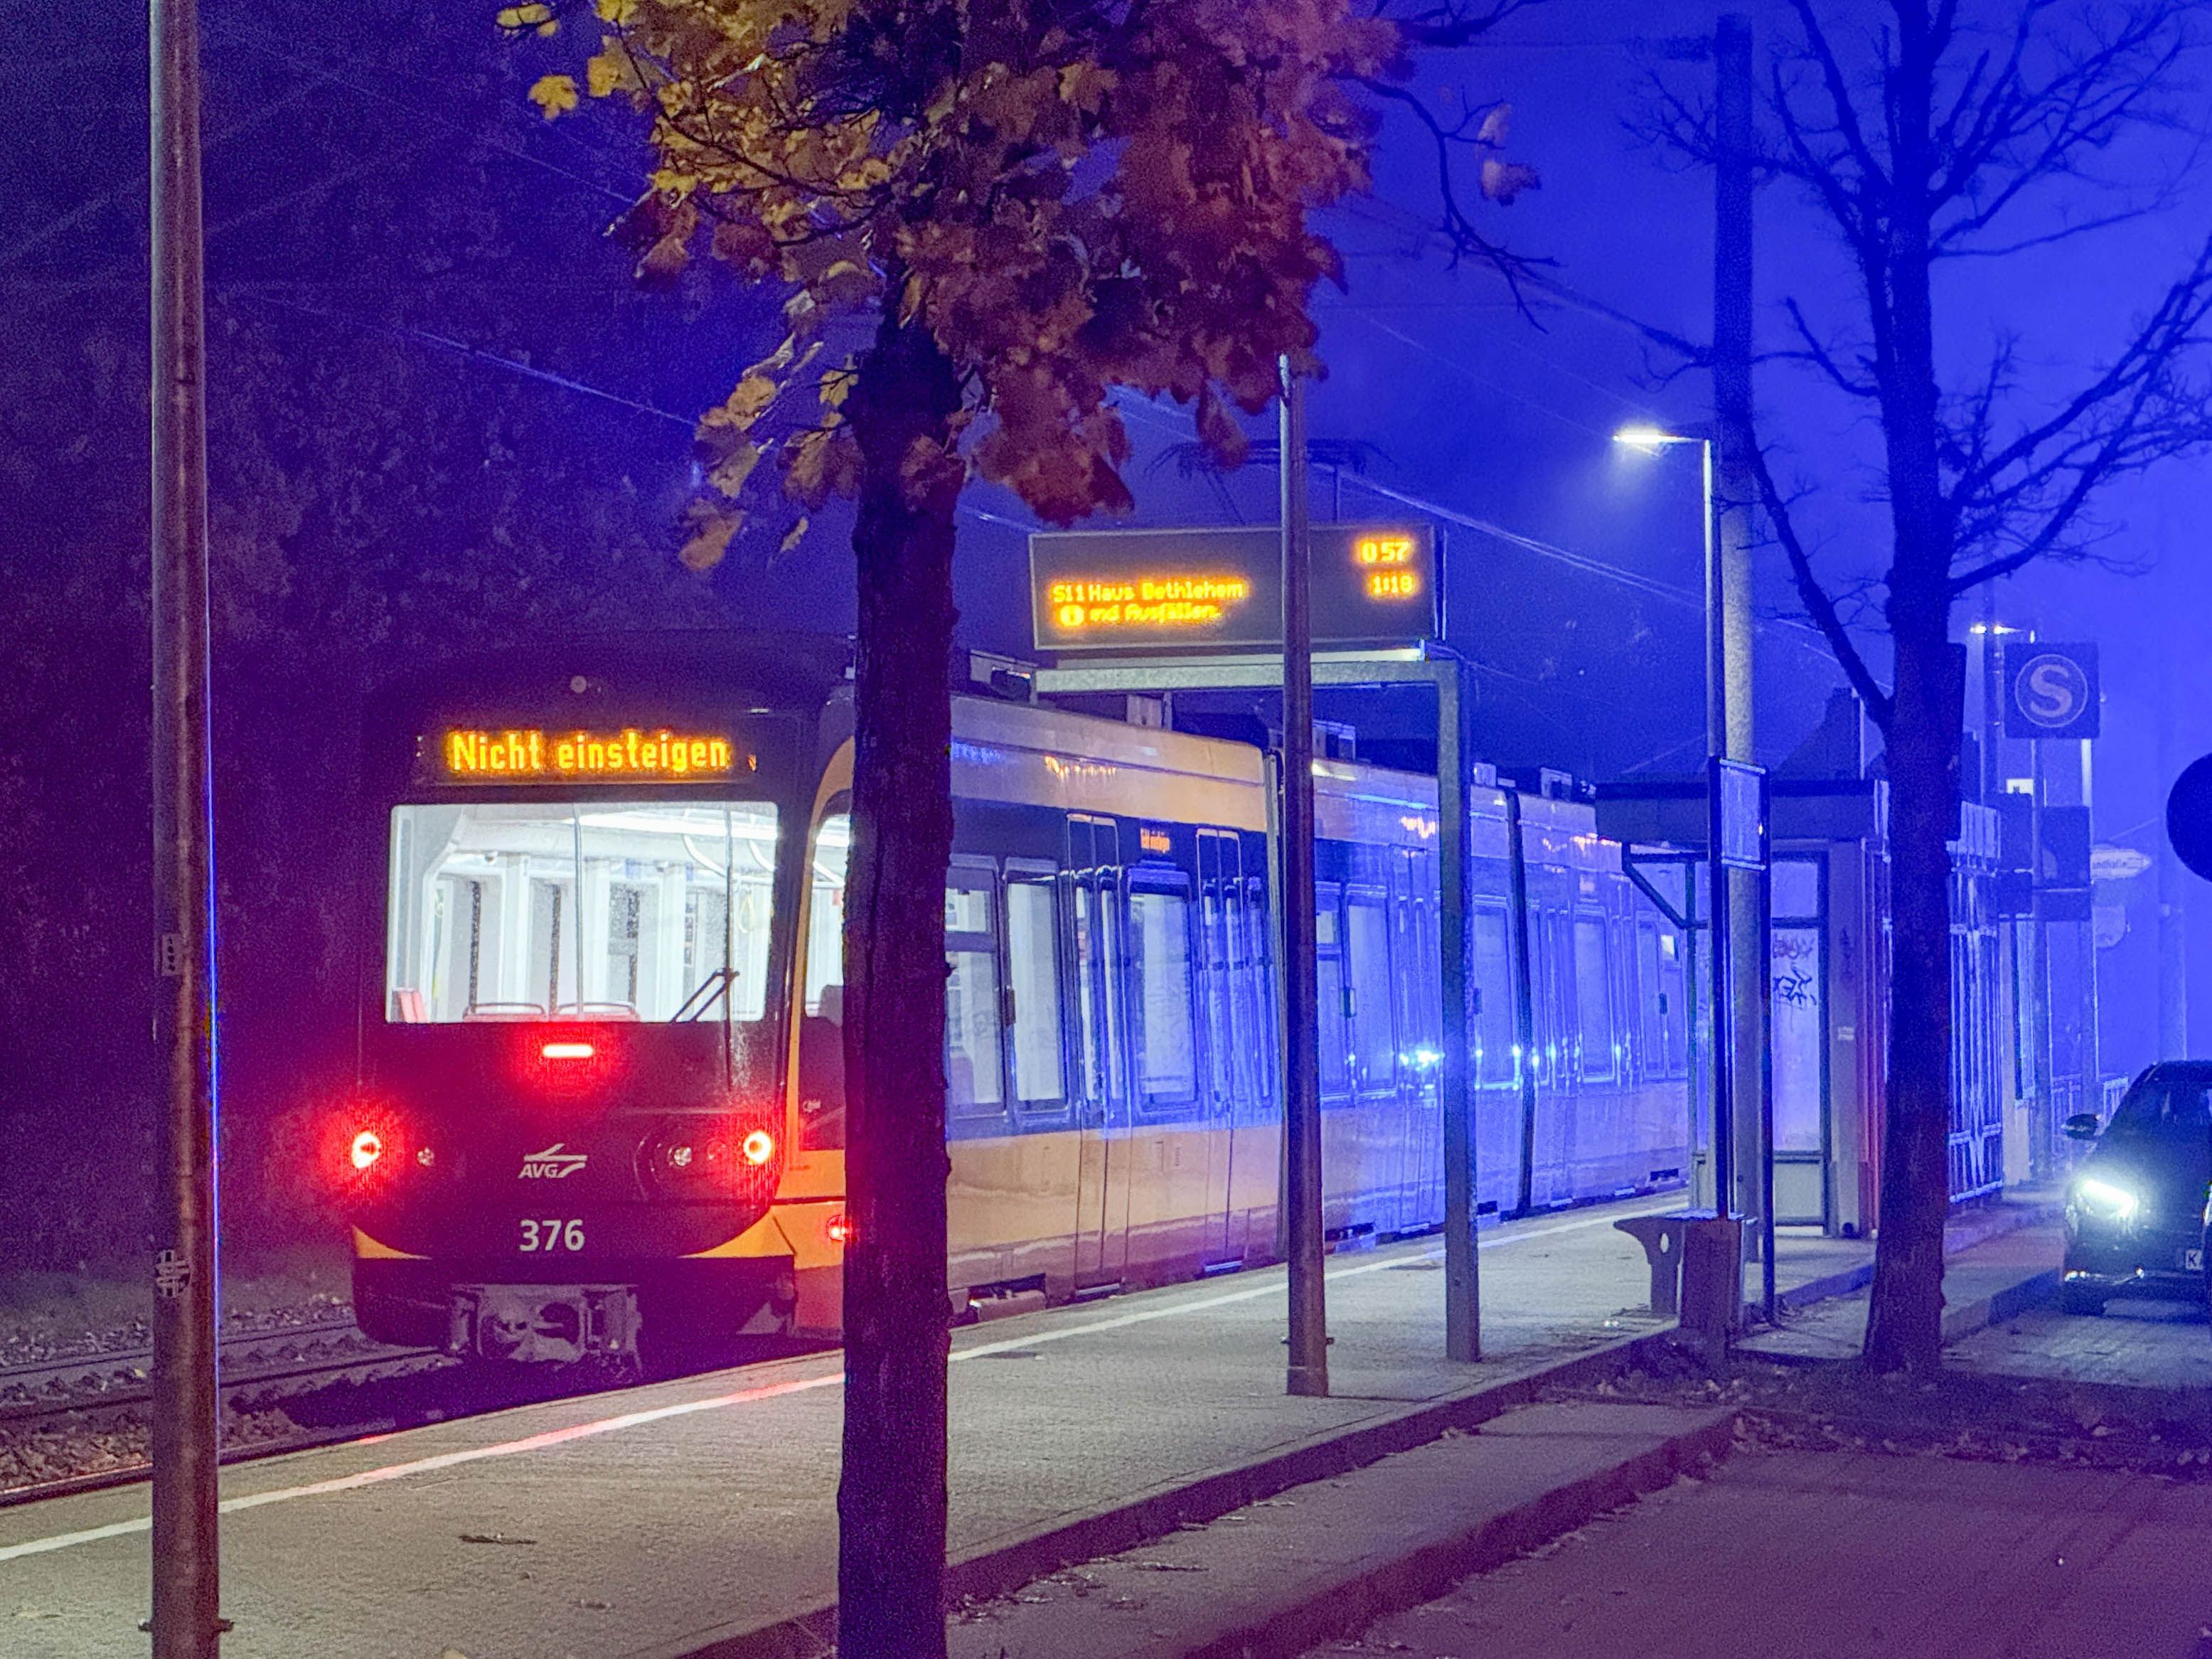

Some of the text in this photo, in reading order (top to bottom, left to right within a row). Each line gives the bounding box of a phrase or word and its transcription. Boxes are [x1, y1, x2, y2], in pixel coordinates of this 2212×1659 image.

[1088, 583, 1136, 602] Haus
[2030, 664, 2073, 718] S
[453, 732, 727, 772] Nicht einsteigen
[518, 1163, 558, 1178] AVG
[519, 1219, 585, 1251] 376
